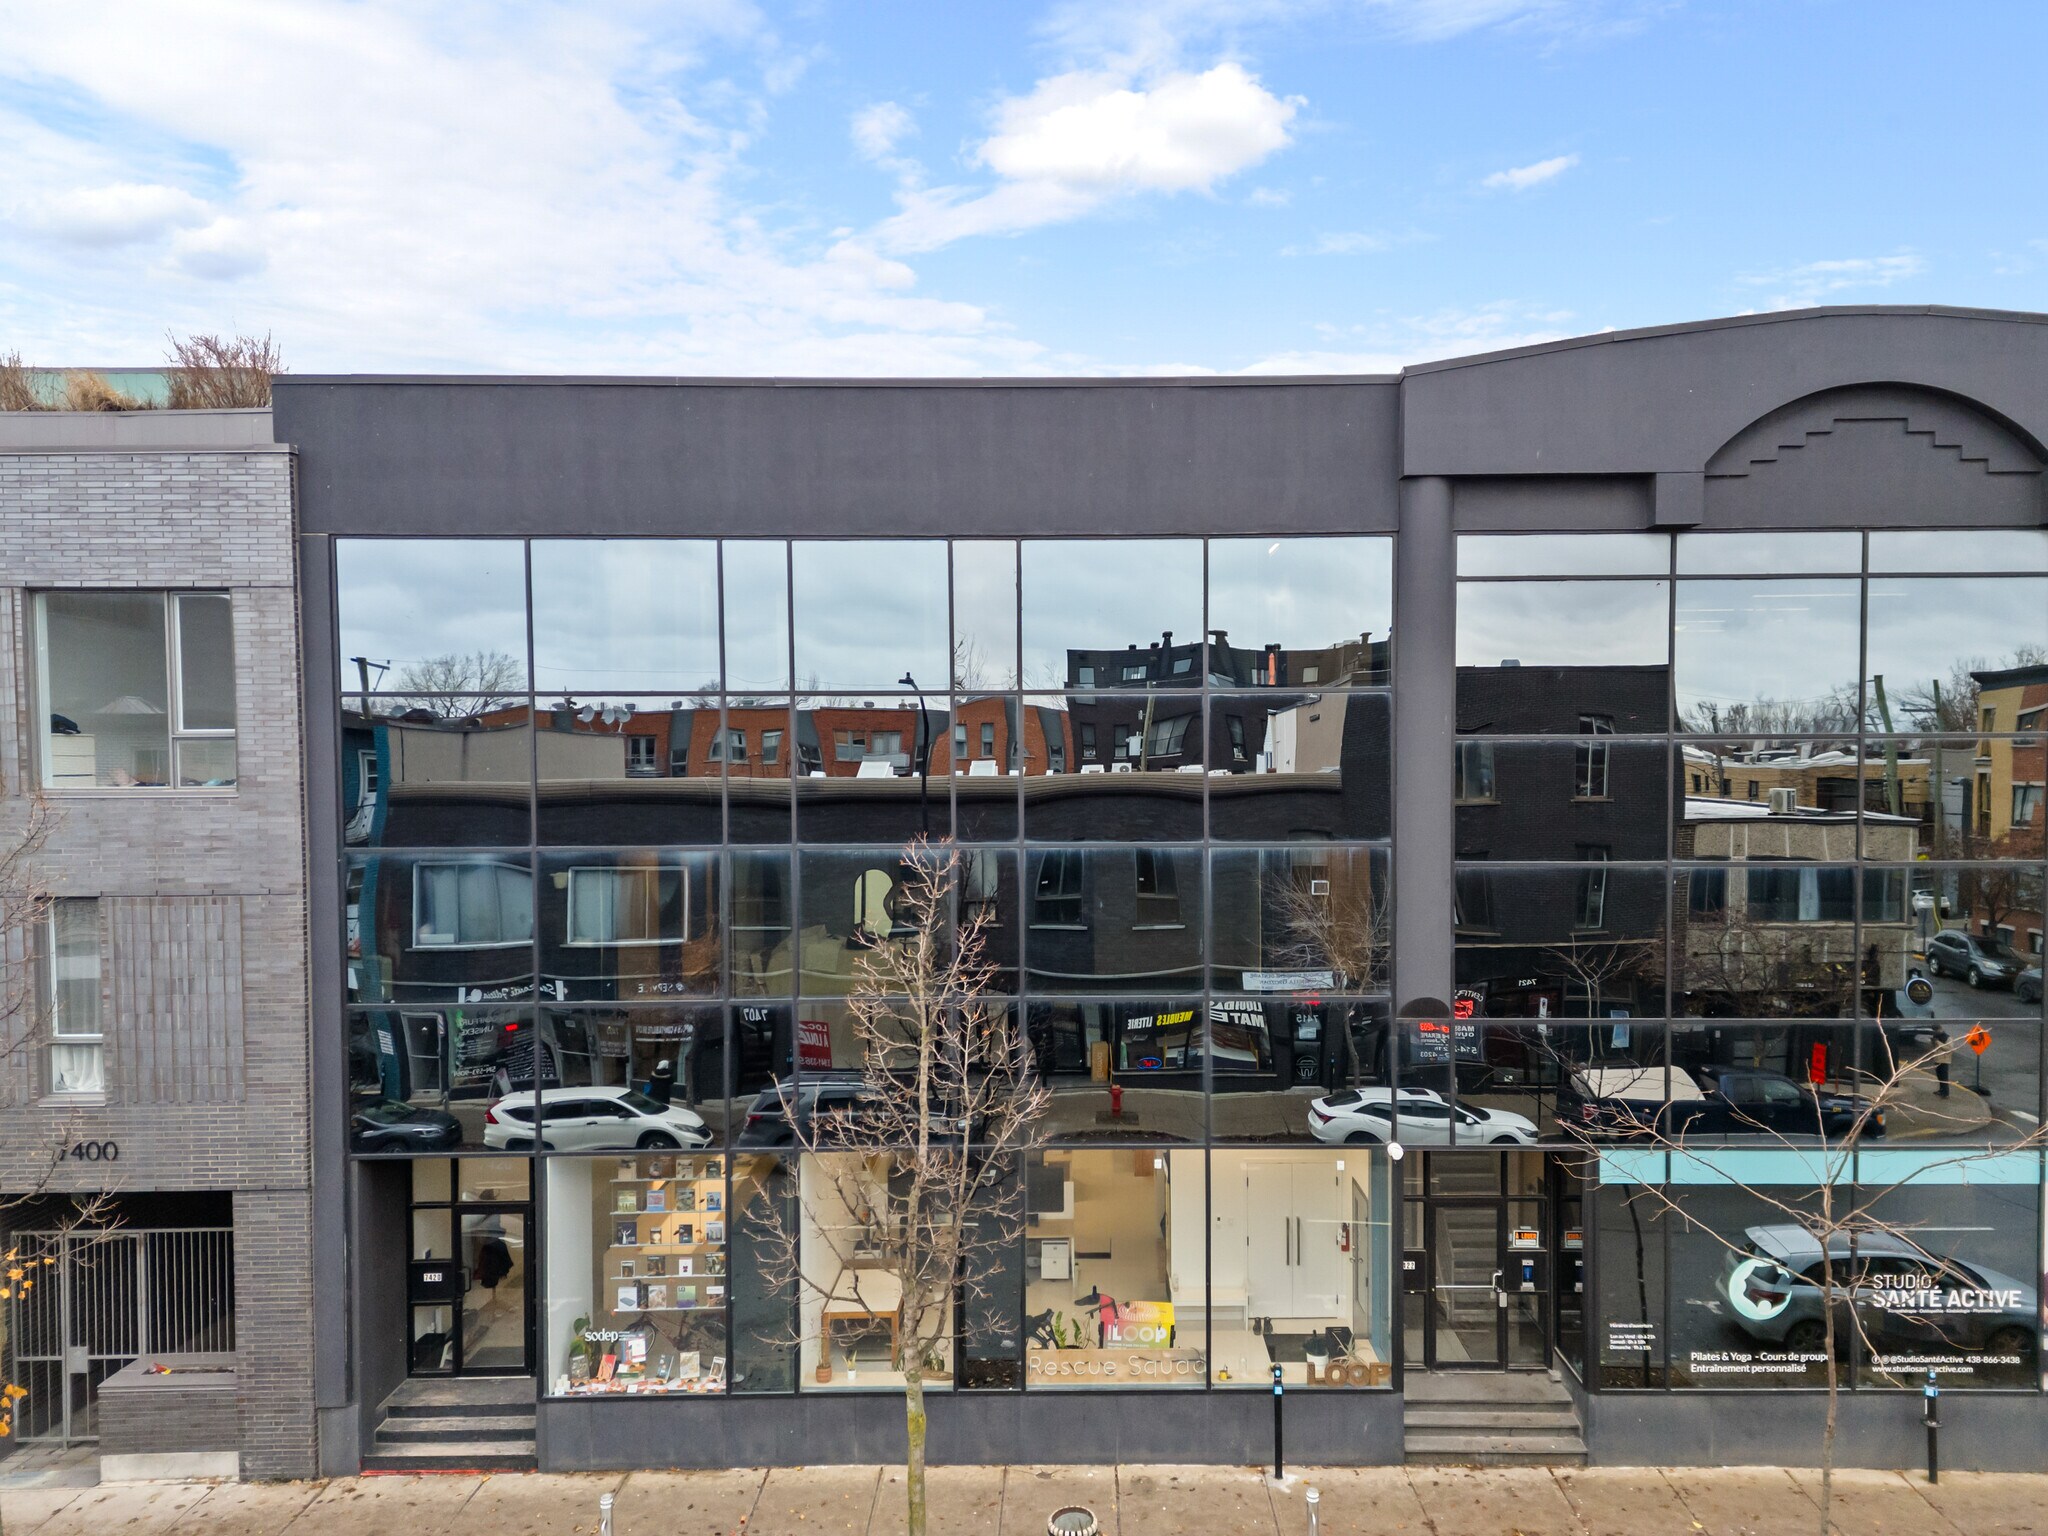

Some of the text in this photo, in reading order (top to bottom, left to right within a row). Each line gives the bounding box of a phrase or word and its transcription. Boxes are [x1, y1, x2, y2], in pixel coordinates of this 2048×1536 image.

[55, 1141, 119, 1161] 7400
[1873, 1274, 1932, 1289] STUDIO
[1872, 1285, 2022, 1308] SANTÉ ACTIVE
[584, 1328, 619, 1343] sodep
[1690, 1352, 1720, 1361] Pilates
[1721, 1352, 1730, 1361] &
[1730, 1352, 1752, 1363] Yoga
[1760, 1352, 1787, 1361] Cours
[1788, 1352, 1799, 1361] de
[1890, 1355, 2021, 1364] @StudioSantéActive 438-866-3438
[1028, 1356, 1117, 1376] Rescue
[1690, 1363, 1807, 1374] Entraînement personnalisé
[1871, 1366, 1974, 1374] www.studiosanactive.com
[1306, 1361, 1392, 1387] LOOP
